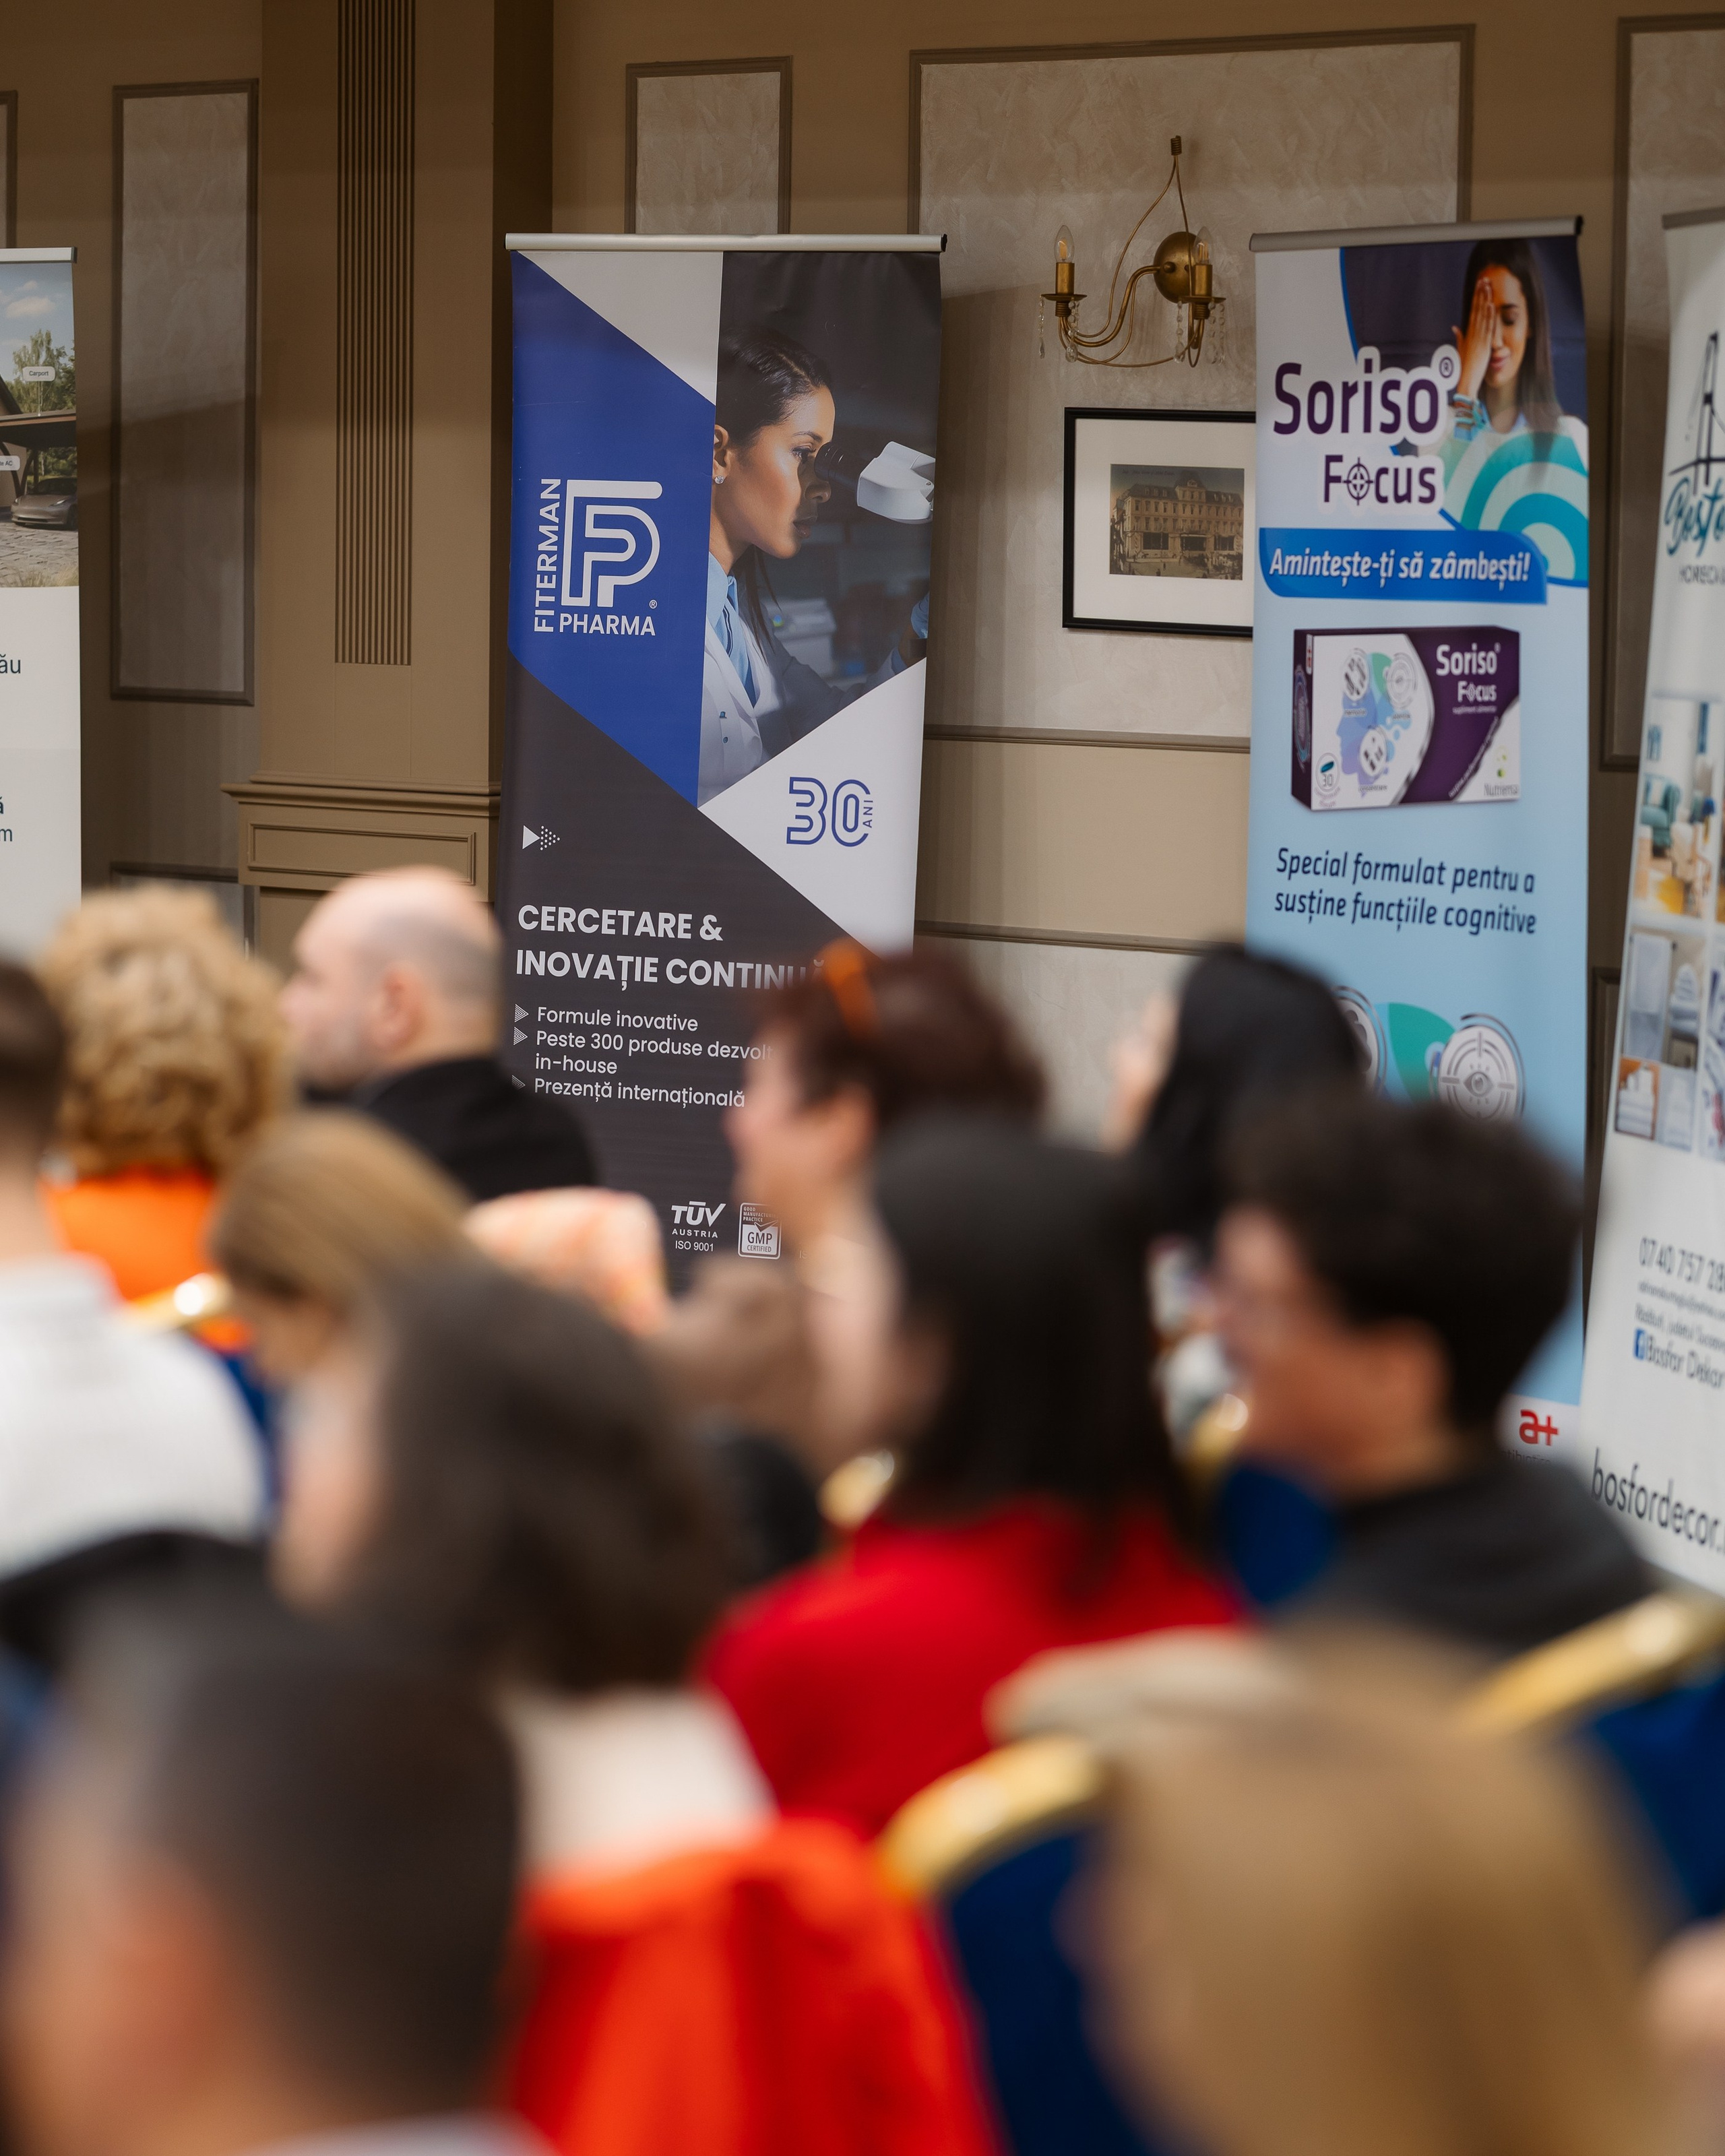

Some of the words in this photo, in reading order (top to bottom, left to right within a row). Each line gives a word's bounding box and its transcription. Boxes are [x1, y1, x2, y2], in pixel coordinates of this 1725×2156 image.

[534, 478, 561, 632] FITERMAN
[1269, 548, 1395, 588] Amintește-ți
[1398, 550, 1423, 579] să
[1429, 551, 1530, 591] zâmbești!
[559, 613, 656, 636] PHARMA
[786, 777, 871, 847] 30
[862, 800, 873, 828] ANI
[1276, 848, 1348, 880] Special
[1352, 852, 1446, 885] formulat
[1451, 865, 1519, 893] pentru
[1524, 873, 1535, 893] a
[518, 904, 693, 939] CERCETARE
[699, 914, 724, 941] &
[1274, 889, 1346, 924] susține
[1352, 892, 1437, 932] funcțiile
[1443, 903, 1536, 936] cognitive
[516, 949, 659, 991] INOVAȚIE
[537, 1007, 611, 1026] Formule
[616, 1010, 699, 1032] inovative
[536, 1030, 586, 1048] Peste
[590, 1033, 623, 1050] 300
[628, 1038, 703, 1056] produse
[535, 1053, 618, 1074] in-house
[534, 1078, 613, 1103] Prezență
[617, 1082, 745, 1109] internațională
[672, 1228, 718, 1238] AUSTRIA
[675, 1240, 691, 1250] ISO
[693, 1242, 714, 1252] 9001
[747, 1232, 773, 1244] GMP
[747, 1244, 772, 1253] CERTIFIED
[1707, 1259, 1725, 1294] 28
[1591, 1446, 1725, 1554] bosfordecor.
